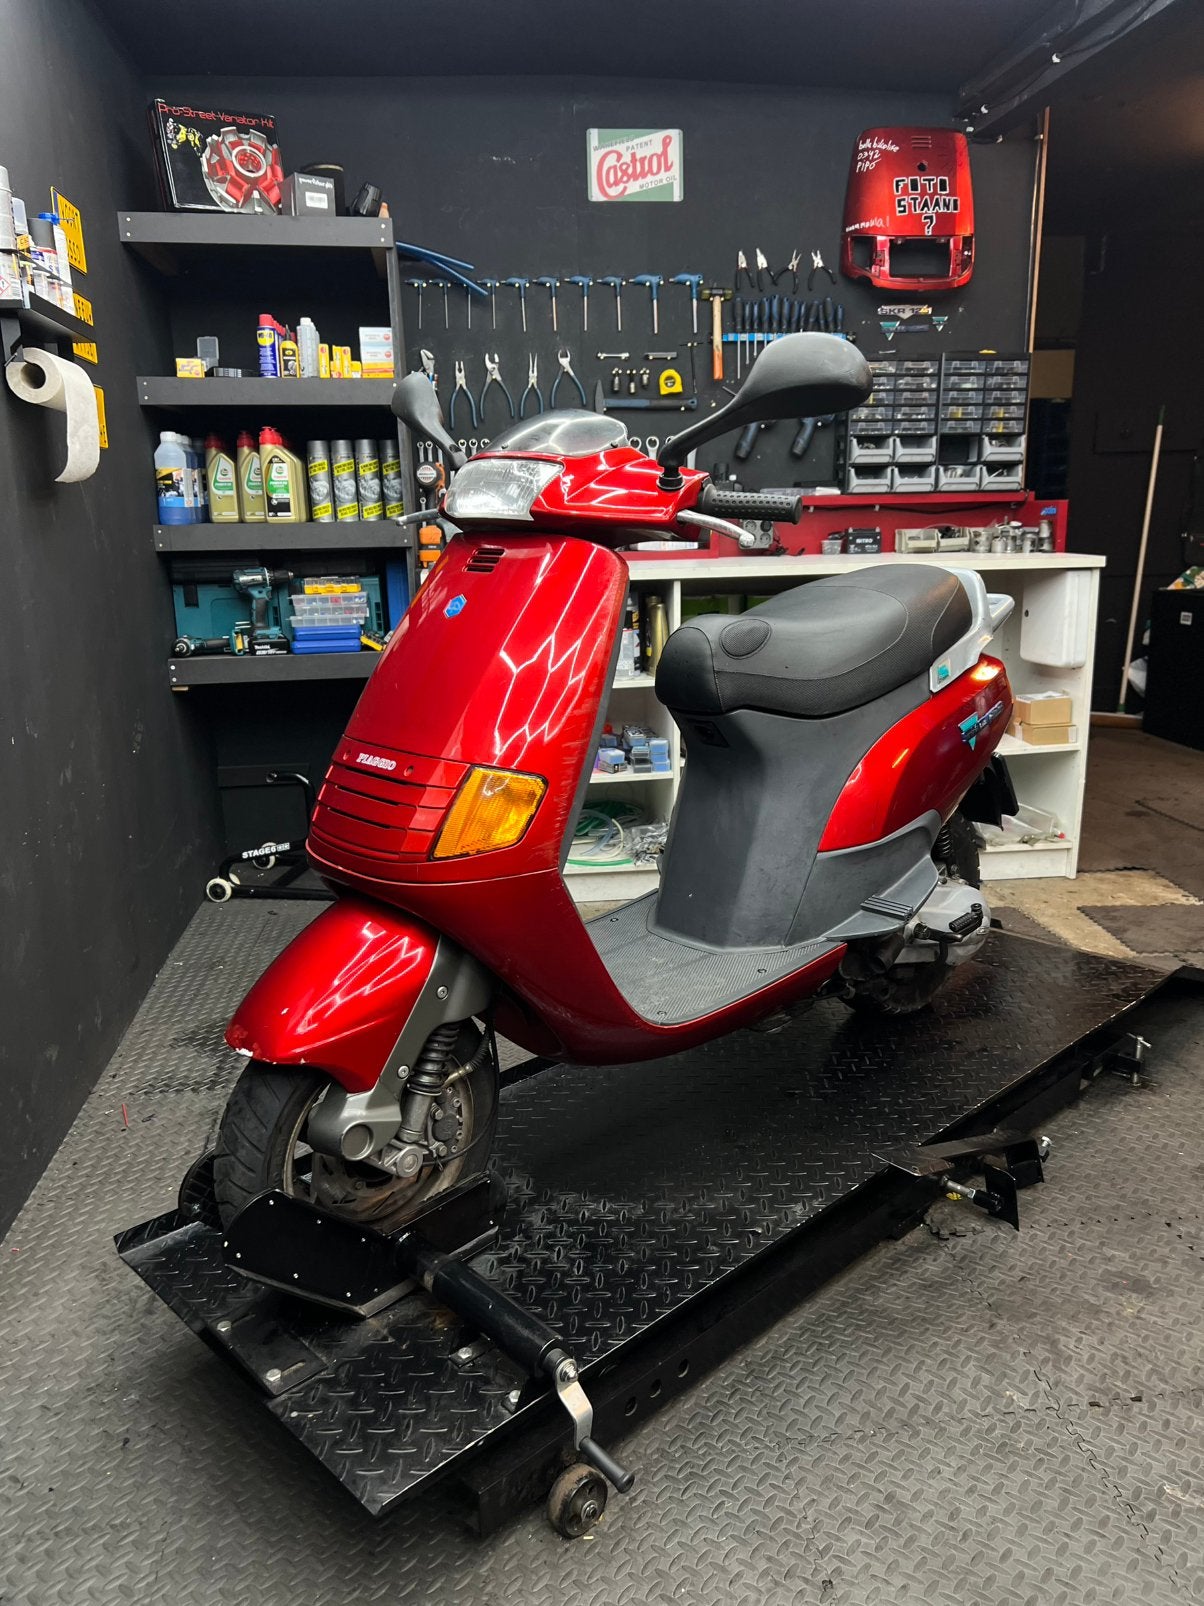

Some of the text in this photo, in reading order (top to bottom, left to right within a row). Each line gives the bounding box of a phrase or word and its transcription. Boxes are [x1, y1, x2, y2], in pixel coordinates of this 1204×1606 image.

[261, 119, 274, 128] Kit
[626, 140, 652, 151] PATENT
[596, 135, 673, 200] Castrol
[639, 179, 663, 189] MOTOR
[893, 176, 950, 194] FOTO
[880, 307, 906, 316] SKR
[356, 752, 397, 771] PIAGGIO
[242, 845, 277, 859] STAGE6
